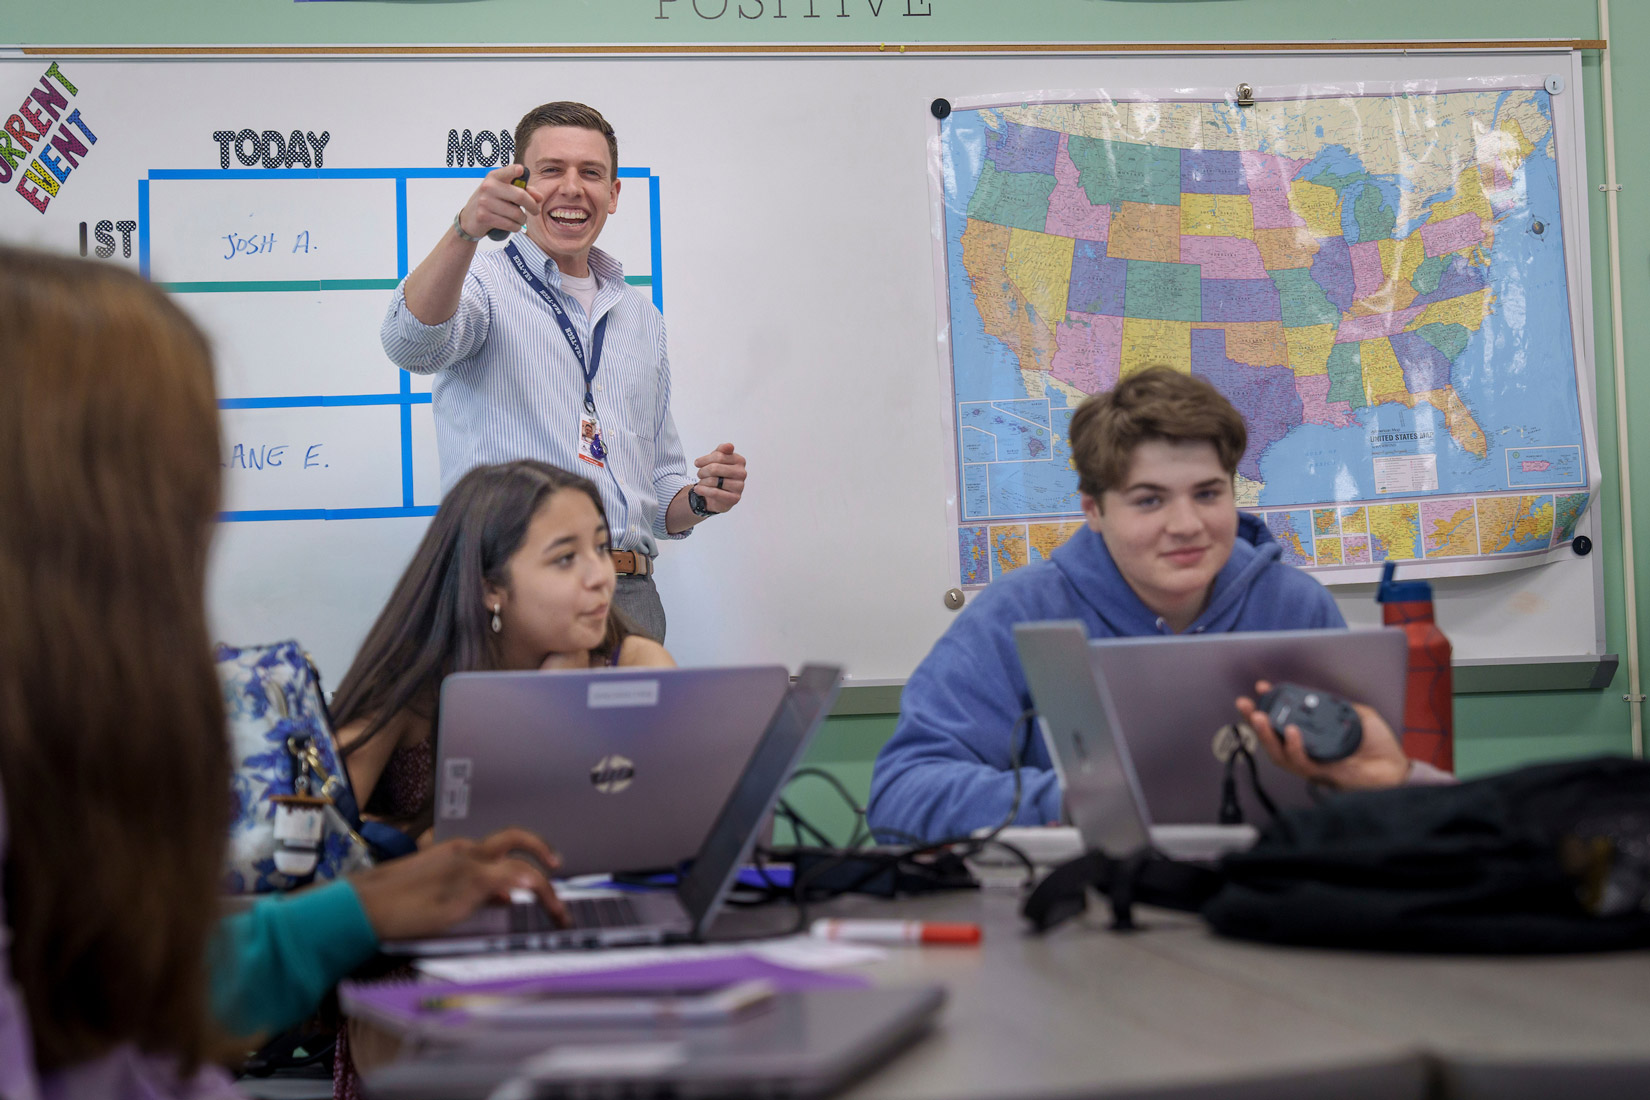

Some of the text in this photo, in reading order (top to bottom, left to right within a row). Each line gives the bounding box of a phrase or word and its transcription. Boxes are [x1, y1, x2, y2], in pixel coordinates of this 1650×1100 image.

[15, 107, 98, 215] EVENT
[213, 128, 330, 169] TODAY
[222, 230, 318, 260] JOSH A.
[1370, 431, 1434, 443] UNITED STATES MAP
[219, 443, 329, 470] ANE E.
